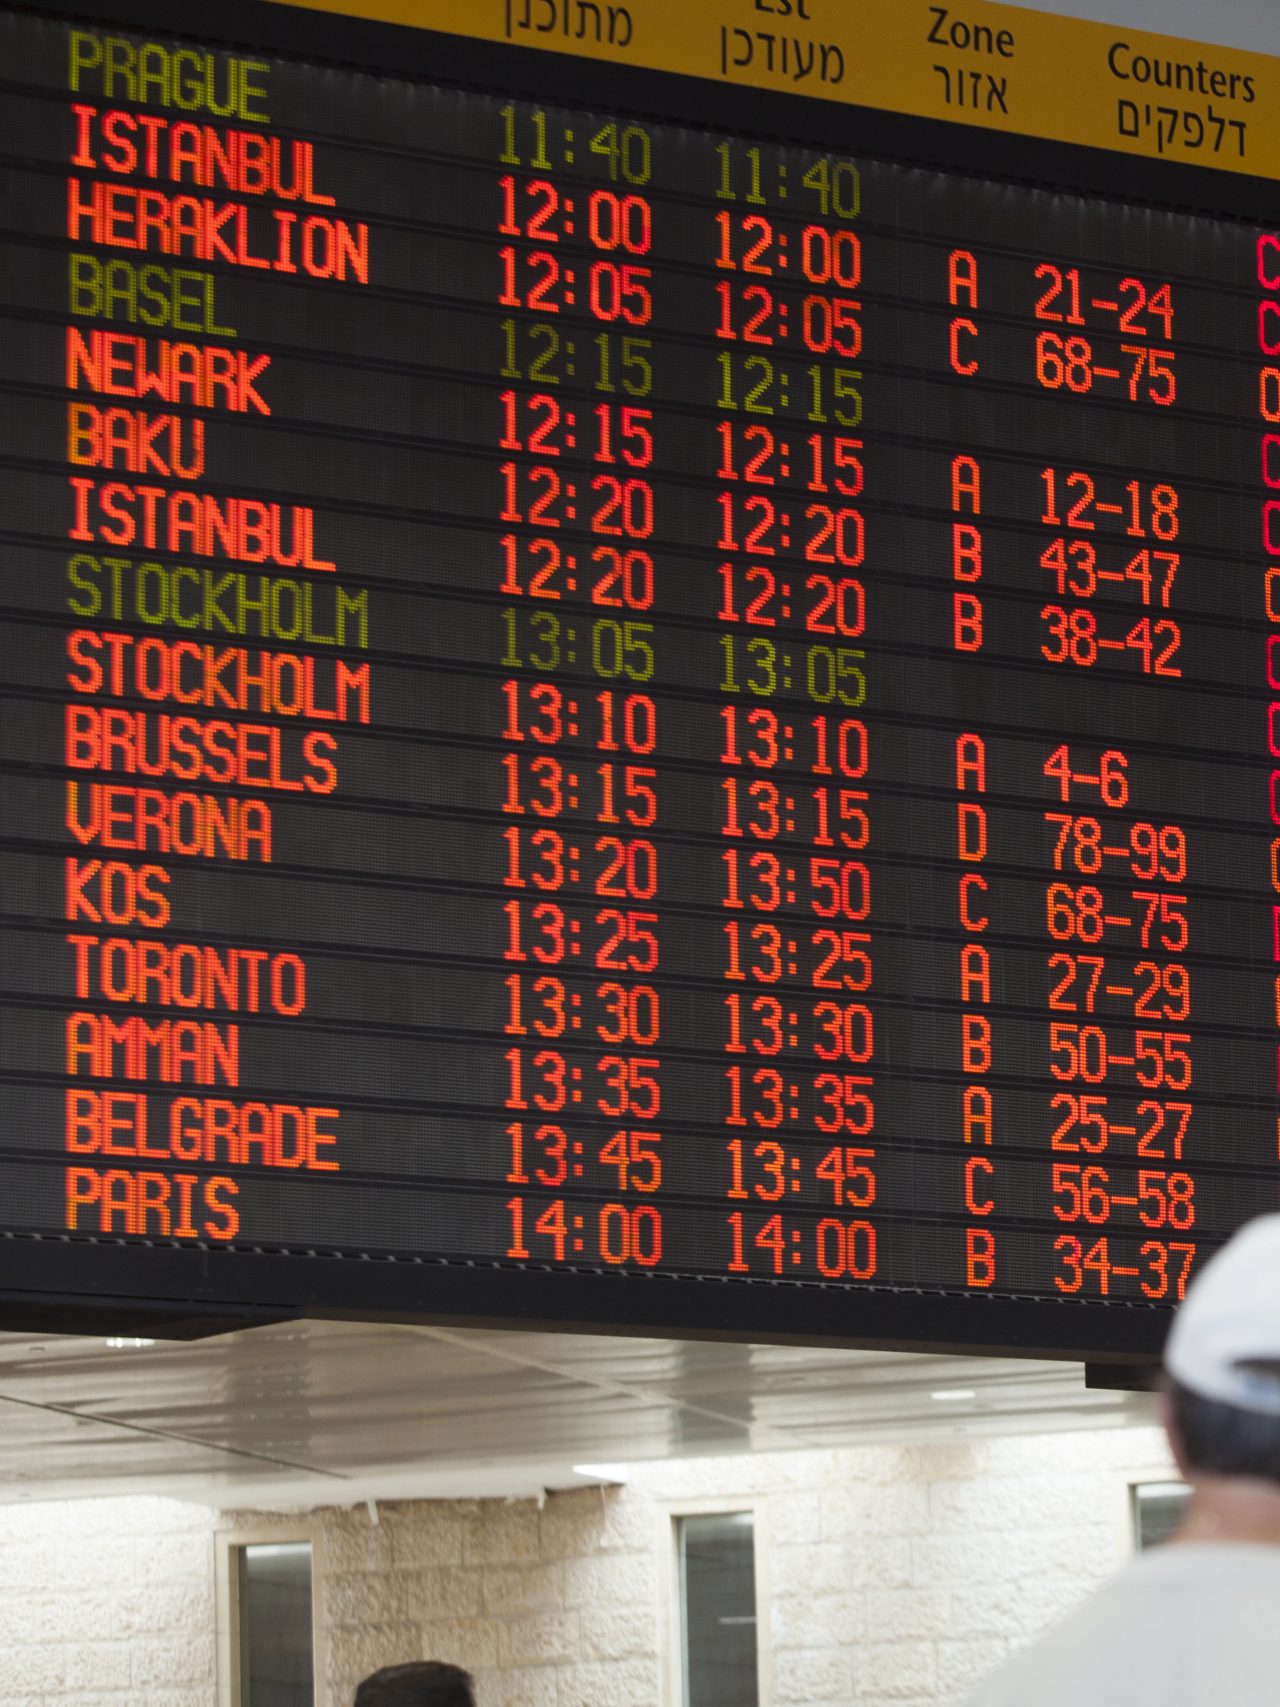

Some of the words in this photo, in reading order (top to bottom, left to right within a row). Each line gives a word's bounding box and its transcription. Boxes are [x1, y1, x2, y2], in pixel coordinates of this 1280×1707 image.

[504, 0, 633, 47] מתוכנן
[719, 25, 845, 84] מעודכן
[927, 6, 1015, 57] Zone
[933, 64, 1009, 115] אזור
[1108, 42, 1256, 103] Counters
[70, 31, 269, 122] PRAGUE
[500, 108, 650, 184] 11:40
[718, 146, 859, 217] 11:40
[1118, 99, 1247, 157] דלפקים
[66, 176, 369, 285] HERAKLION
[498, 245, 653, 326] 12:05
[715, 280, 862, 359] 12:05
[949, 316, 979, 376] C
[1035, 331, 1176, 407] 68-75
[70, 103, 336, 207] ISTANBUL
[497, 175, 652, 256] 12:00
[714, 210, 862, 289] 12:00
[948, 248, 979, 309] A
[1033, 263, 1175, 340] 21-24
[70, 253, 236, 336] BASEL
[502, 320, 651, 395] 12:15
[717, 352, 862, 426] 12:15
[65, 326, 272, 416] NEWARK
[498, 389, 654, 469] 12:15
[716, 421, 864, 497] 12:15
[950, 454, 981, 515] A
[1040, 466, 1180, 542] 12-18
[66, 401, 205, 480] BAKU
[499, 461, 654, 540] 12:20
[715, 491, 865, 567] 12:20
[951, 522, 982, 583] B
[1039, 537, 1181, 608] 43-47
[67, 476, 337, 572] ISTANBUL
[499, 533, 655, 611] 12:20
[717, 562, 866, 637] 12:20
[953, 592, 983, 652] B
[1040, 604, 1183, 678] 38-42
[68, 555, 368, 648] STOCKHOLM
[502, 609, 654, 681] 13:05
[720, 635, 866, 706] 13:05
[64, 704, 338, 795] BRUSSELS
[501, 752, 657, 828] 13:15
[721, 776, 870, 850] 13:15
[957, 801, 988, 863] D
[1043, 811, 1187, 884] 78-99
[66, 628, 371, 725] STOCKHOLM
[501, 679, 656, 755] 13:10
[720, 705, 869, 779] 13:10
[955, 732, 986, 793] A
[1042, 744, 1129, 809] 4-6
[65, 780, 272, 864] VERONA
[501, 825, 658, 901] 13:20
[721, 848, 871, 921] 13:50
[959, 872, 990, 933] C
[1046, 881, 1189, 952] 68-75
[65, 856, 172, 929] KOS
[502, 899, 660, 973] 13:25
[722, 920, 873, 992] 13:25
[960, 943, 991, 1004] A
[1047, 952, 1191, 1021] 27-29
[65, 933, 306, 1017] TORONTO
[503, 973, 660, 1046] 13:30
[723, 992, 874, 1064] 13:30
[961, 1013, 992, 1074] B
[1049, 1021, 1192, 1091] 50-55
[65, 1010, 240, 1089] AMMAN
[503, 1047, 661, 1119] 13:35
[724, 1065, 875, 1136] 13:35
[962, 1085, 993, 1146] A
[1049, 1093, 1193, 1161] 25-27
[64, 1087, 341, 1172] BELGRADE
[505, 1121, 662, 1193] 13:45
[726, 1138, 877, 1208] 13:45
[964, 1155, 995, 1216] C
[1051, 1162, 1196, 1231] 56-58
[65, 1166, 240, 1241] PARIS
[506, 1196, 663, 1267] 14:00
[727, 1211, 878, 1280] 14:00
[965, 1227, 996, 1288] B
